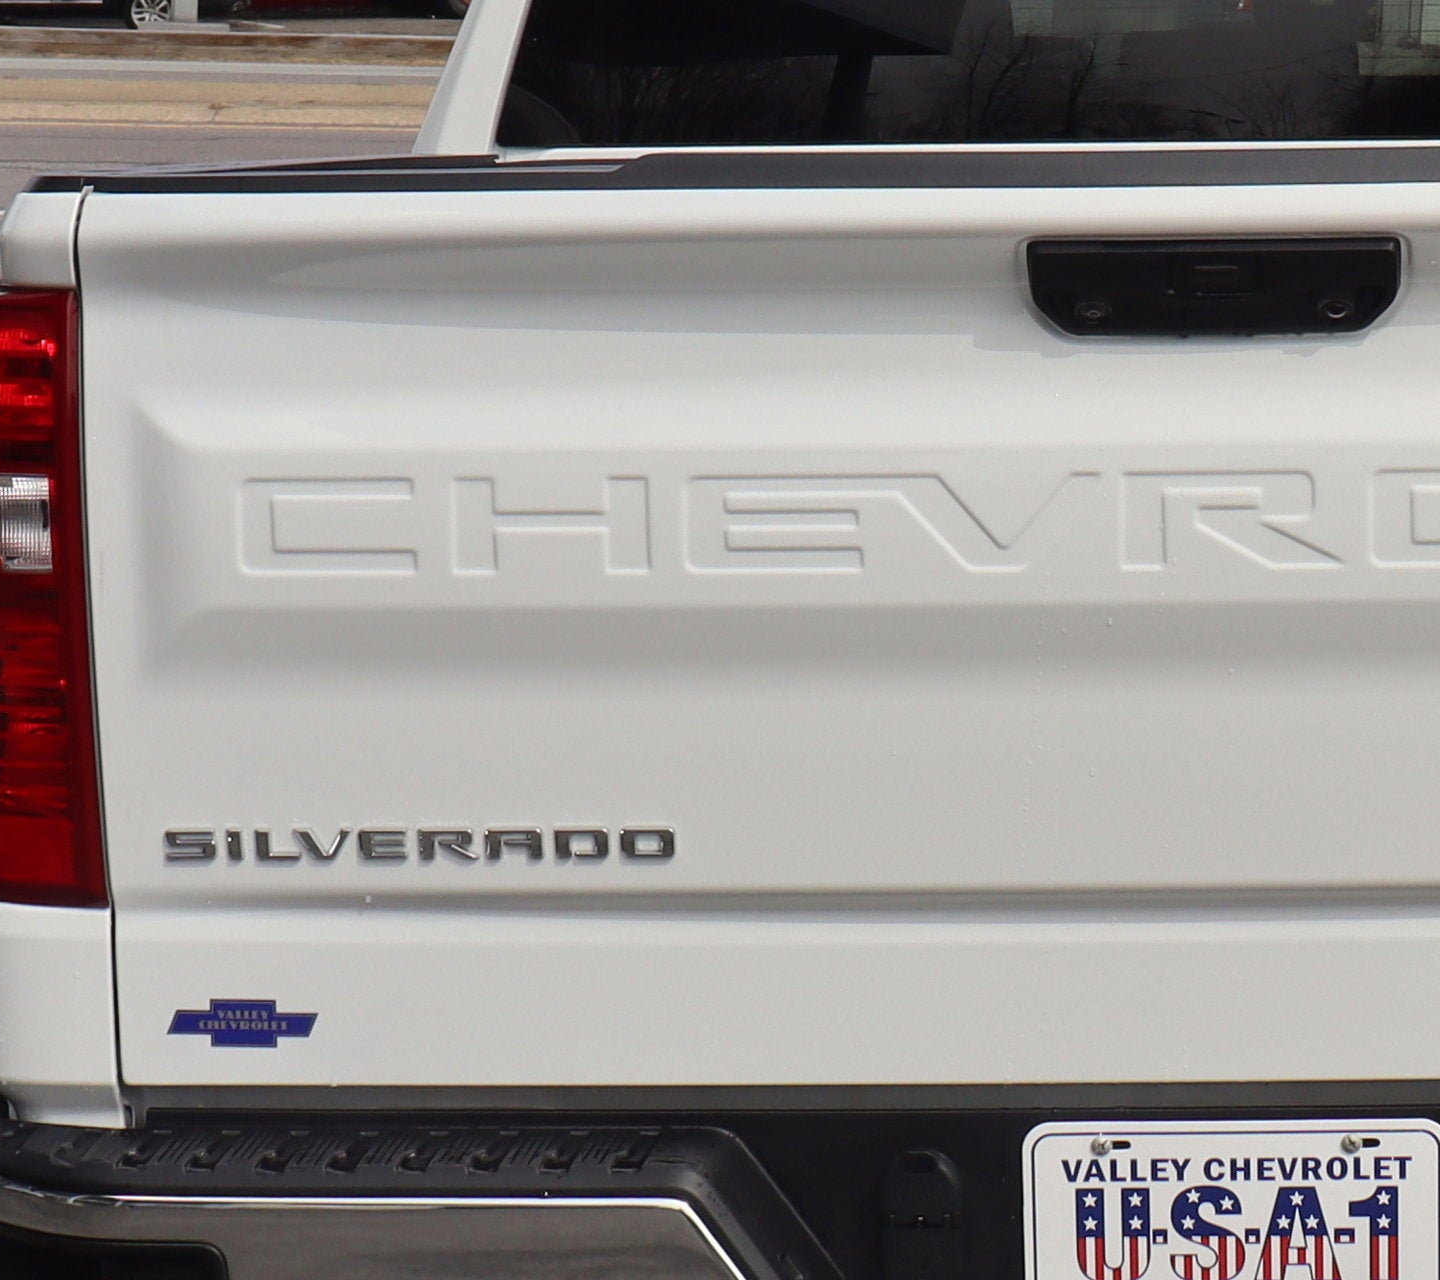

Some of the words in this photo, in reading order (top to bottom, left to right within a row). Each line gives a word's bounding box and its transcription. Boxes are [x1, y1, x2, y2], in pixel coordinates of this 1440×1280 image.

[164, 826, 676, 862] SILVERADO
[216, 1010, 270, 1020] VALLEY
[198, 1020, 289, 1031] CHEVROLET
[1061, 1158, 1191, 1183] VALLEY
[1203, 1156, 1412, 1181] CHEVROLET
